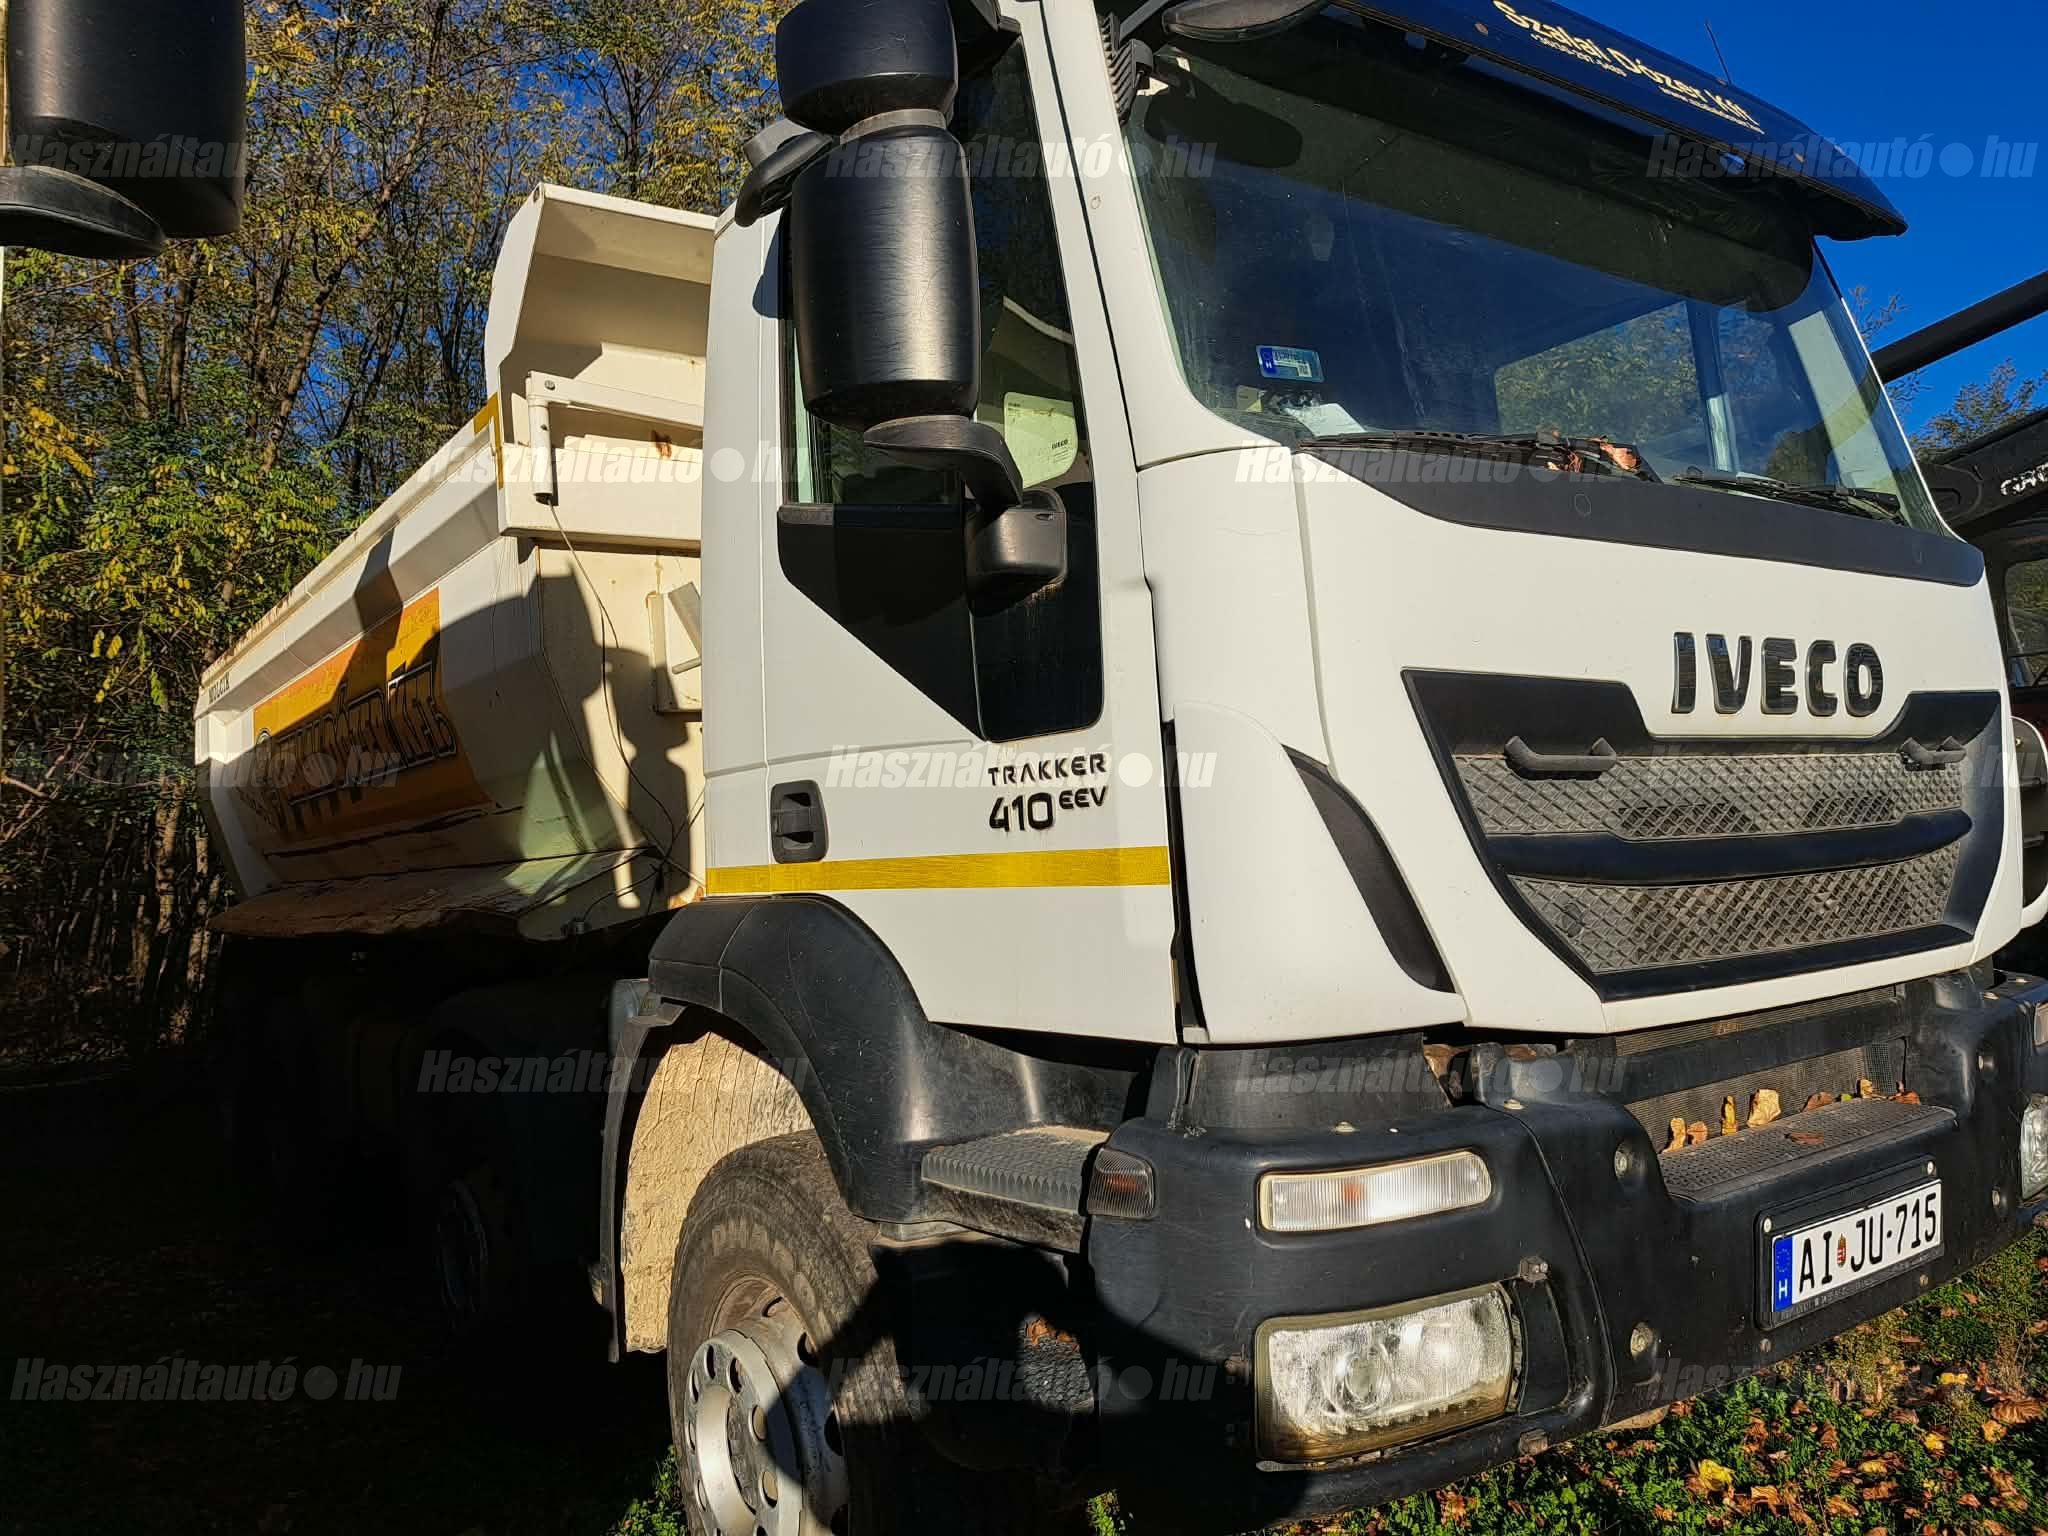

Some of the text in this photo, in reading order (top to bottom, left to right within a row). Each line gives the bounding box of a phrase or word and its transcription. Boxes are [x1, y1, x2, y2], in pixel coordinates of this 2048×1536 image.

[1671, 632, 1883, 717] IVECO
[988, 753, 1107, 786] TRAKKER
[989, 786, 1109, 832] 410 EEV
[1799, 1231, 1832, 1293] AI
[1778, 1279, 1788, 1300] H
